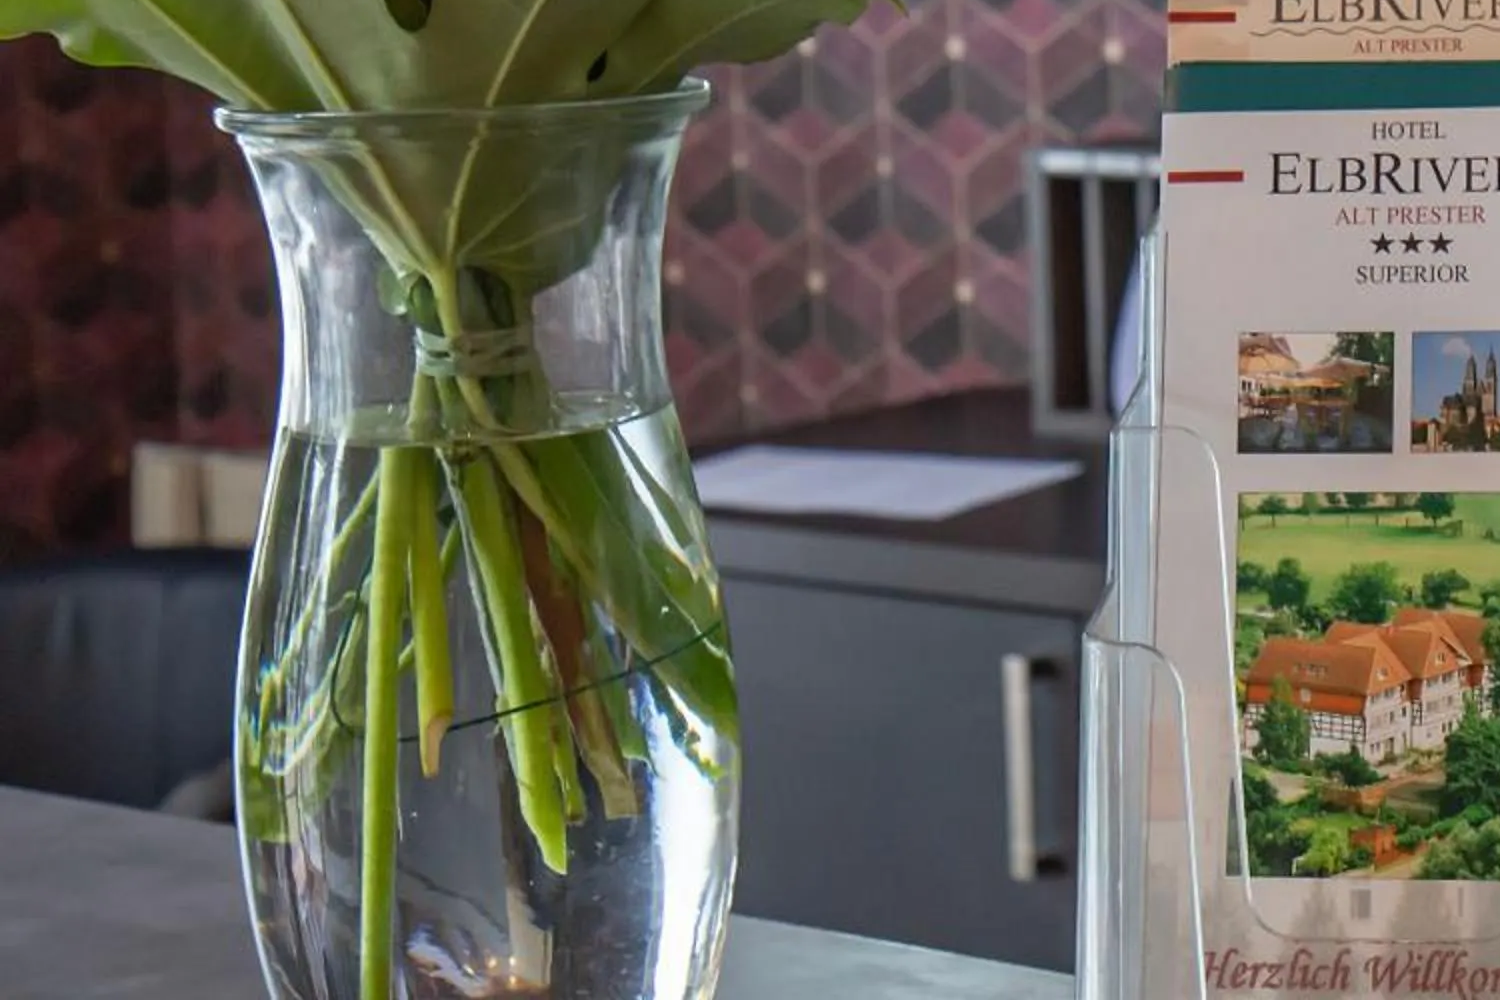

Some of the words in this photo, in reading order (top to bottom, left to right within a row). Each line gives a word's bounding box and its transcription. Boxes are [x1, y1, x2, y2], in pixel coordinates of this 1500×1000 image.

[1353, 38, 1386, 54] ALT
[1389, 37, 1464, 54] PRESTER
[1371, 120, 1446, 140] HOTEL
[1334, 206, 1379, 226] ALT
[1386, 205, 1487, 225] PRESTER
[1355, 264, 1470, 285] SUPERIOR
[1204, 948, 1352, 990] Herzlich
